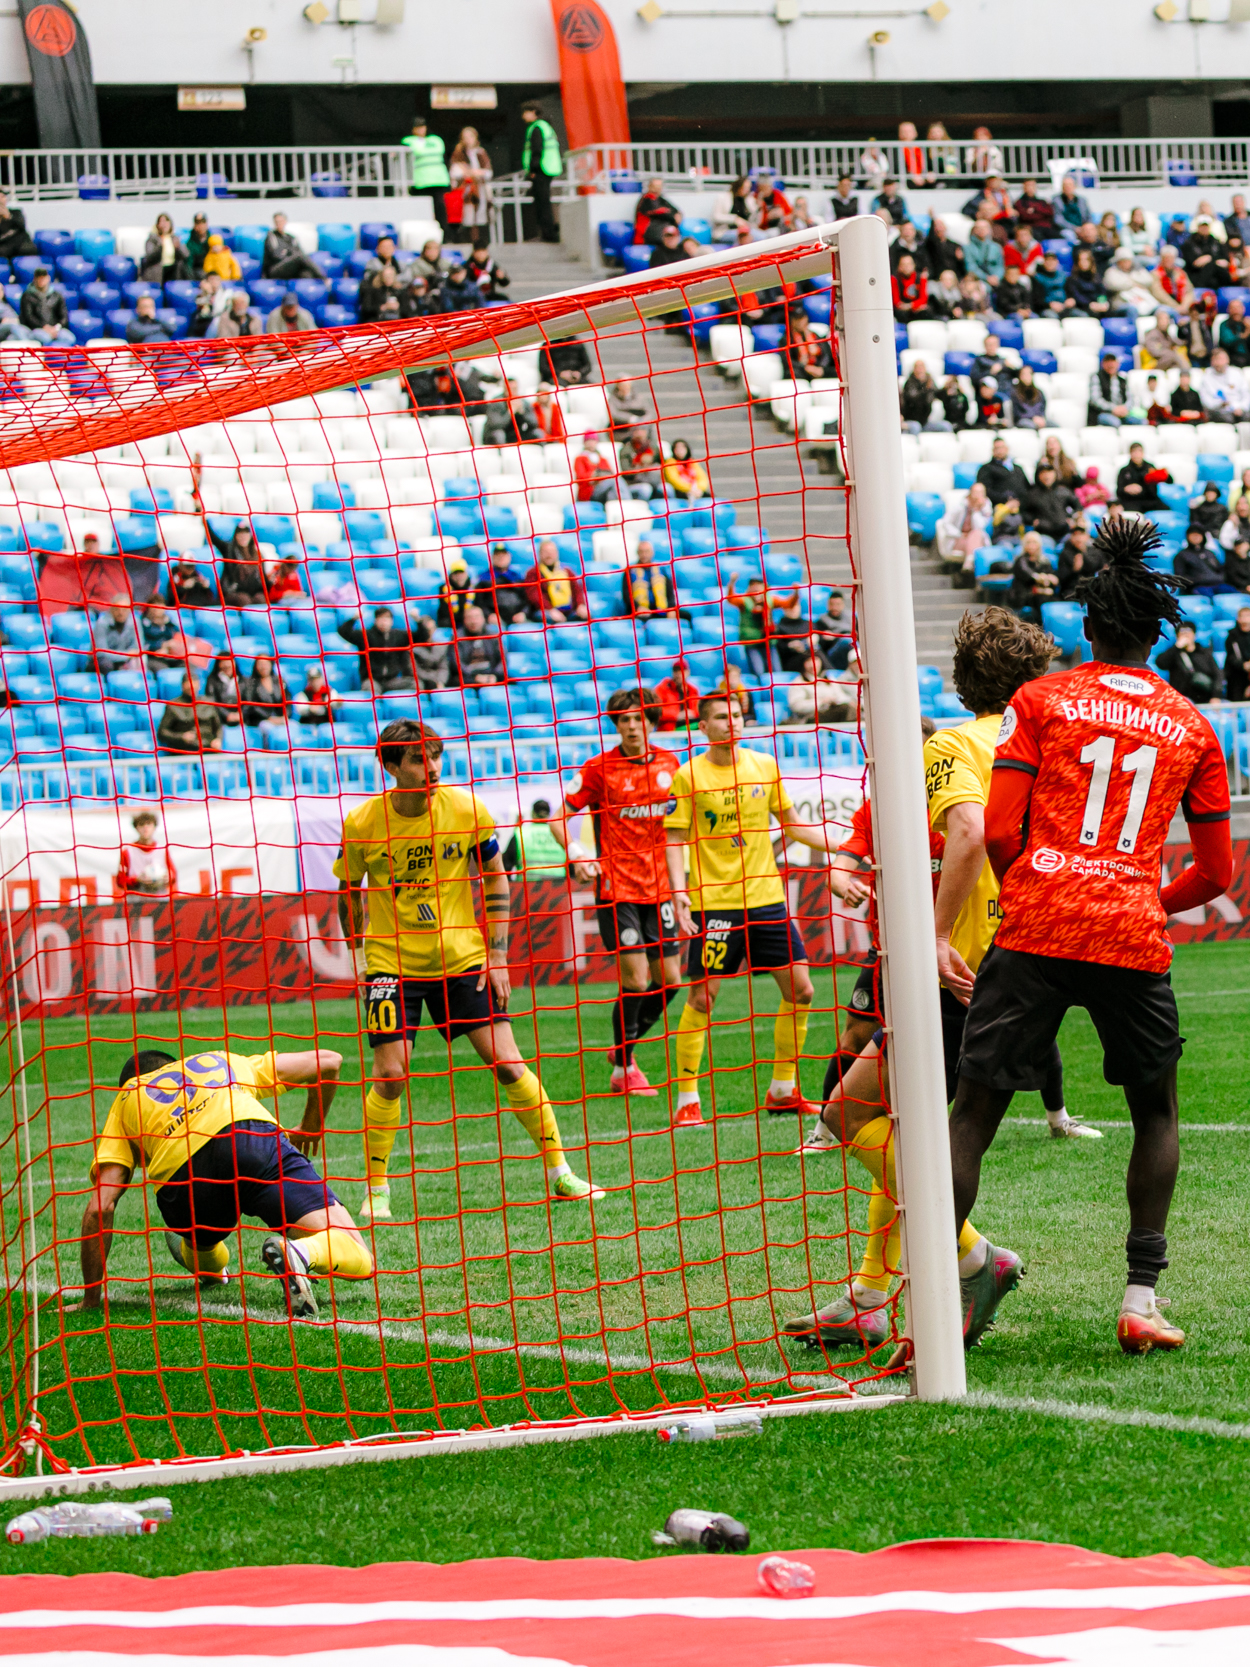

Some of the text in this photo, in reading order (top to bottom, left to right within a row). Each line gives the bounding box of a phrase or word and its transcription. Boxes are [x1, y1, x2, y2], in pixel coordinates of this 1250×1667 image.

[1110, 677, 1145, 691] RIFAR
[1060, 699, 1188, 747] БЕНШИМОЛ
[925, 756, 956, 786] FON
[926, 770, 956, 801] BET
[1078, 735, 1159, 855] 11
[406, 845, 433, 860] FON
[408, 857, 434, 871] BET
[1070, 863, 1116, 881] САМАРА
[1071, 855, 1146, 879] ЭЛЕКТРОЩИТ
[660, 902, 675, 930] 9
[706, 918, 732, 931] FON
[705, 930, 731, 941] BET
[701, 940, 728, 970] 62
[371, 976, 399, 988] FON
[369, 986, 396, 1000] BET
[366, 999, 397, 1034] 40
